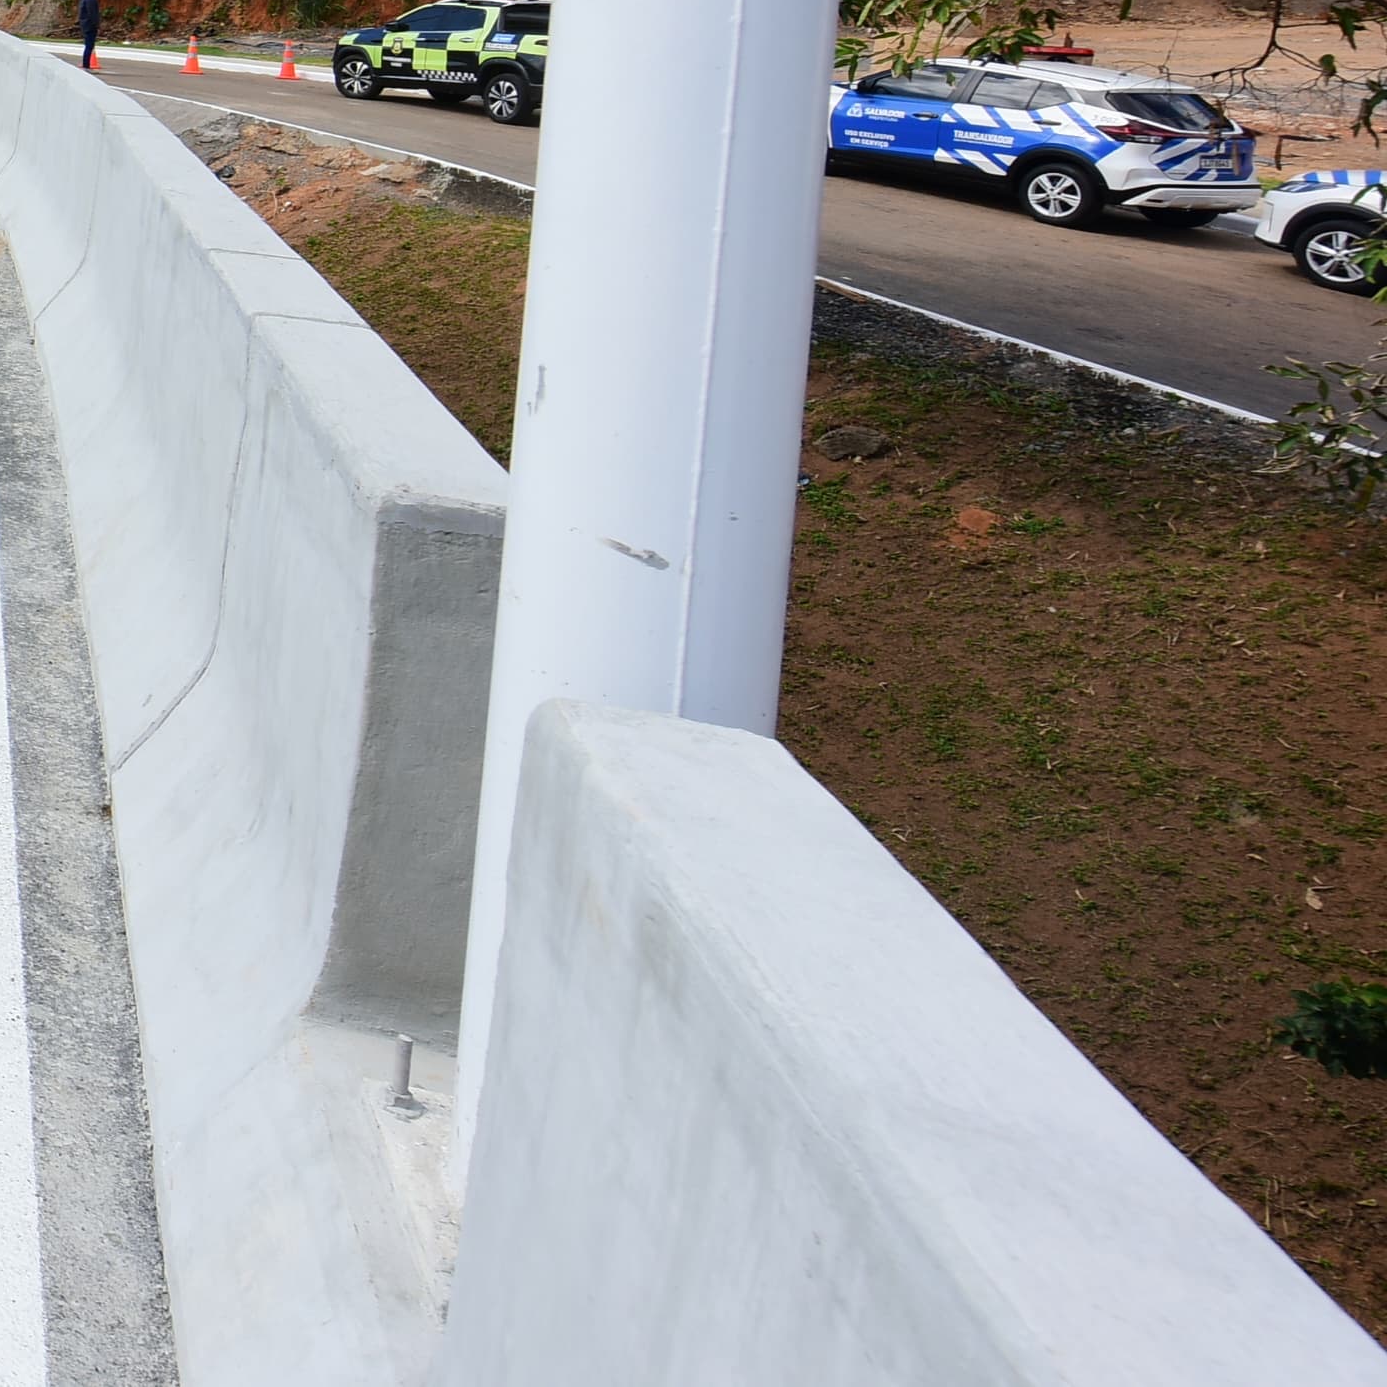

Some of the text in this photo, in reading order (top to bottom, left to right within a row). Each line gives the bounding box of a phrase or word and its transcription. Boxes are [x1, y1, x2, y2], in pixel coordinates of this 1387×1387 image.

[864, 107, 906, 119] SALVADOR
[844, 129, 896, 141] USO EXCLUSIVO
[953, 129, 1015, 144] TRANSALVADOR
[862, 138, 889, 148] SERVIÇO
